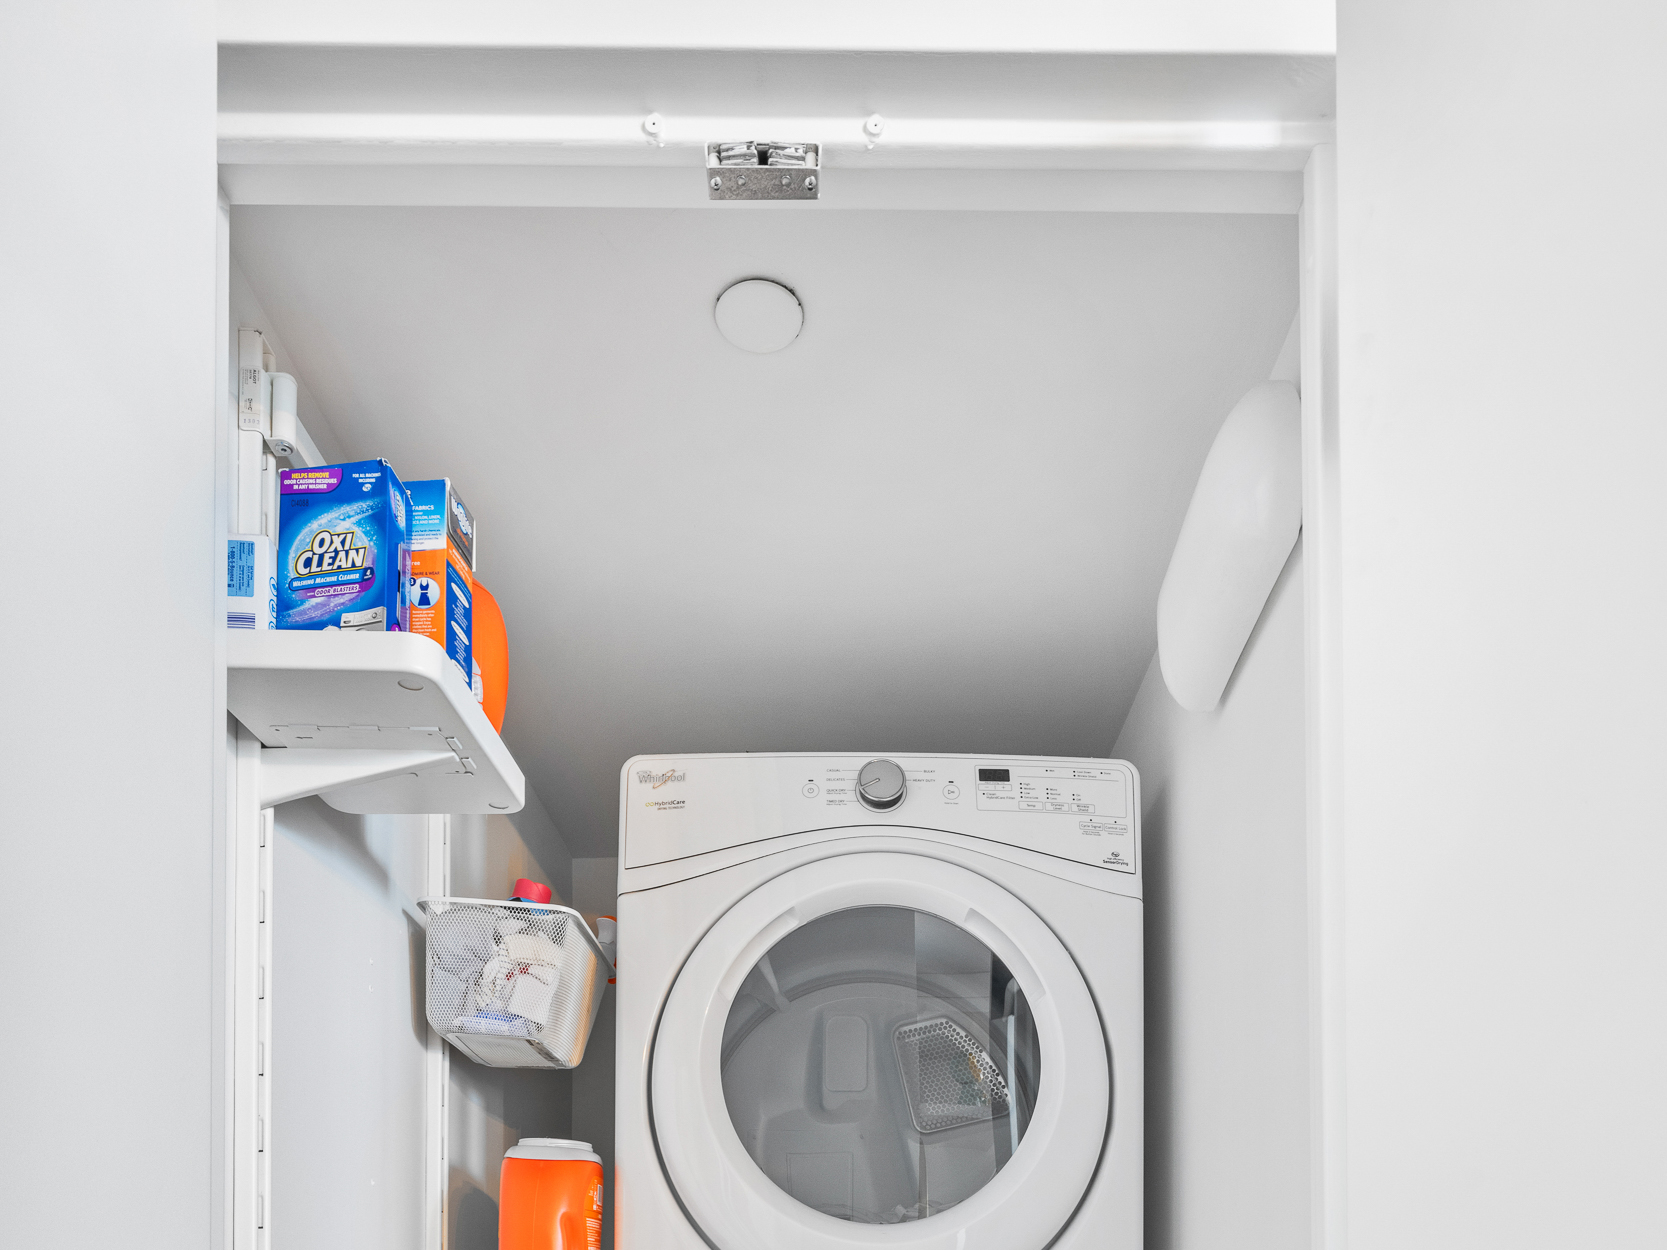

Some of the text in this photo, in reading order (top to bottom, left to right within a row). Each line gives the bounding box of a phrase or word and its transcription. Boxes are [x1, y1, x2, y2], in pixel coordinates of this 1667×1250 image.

[312, 530, 354, 555] OXI
[296, 548, 366, 576] CLEAN
[292, 579, 314, 587] WASHING
[315, 576, 337, 584] MACHINE
[333, 585, 359, 593] BLASTERS
[638, 772, 686, 786] Whirlpool
